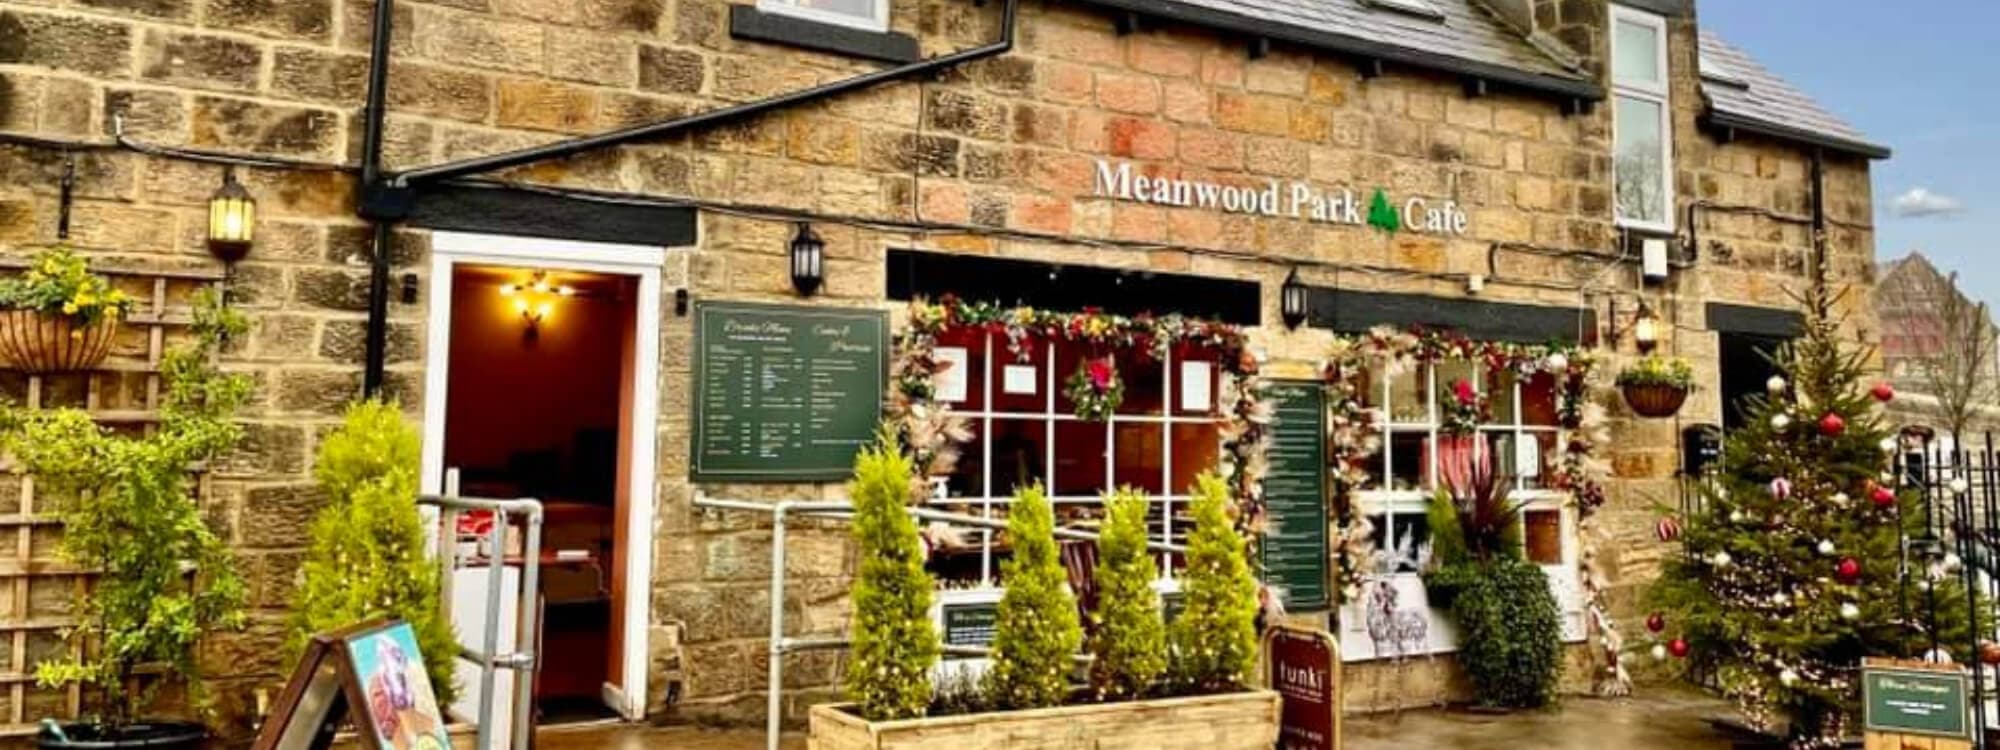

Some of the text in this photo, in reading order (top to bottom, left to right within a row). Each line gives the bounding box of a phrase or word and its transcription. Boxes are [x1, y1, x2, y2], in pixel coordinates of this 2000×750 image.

[1094, 160, 1468, 235] Meanwood Park Cafe
